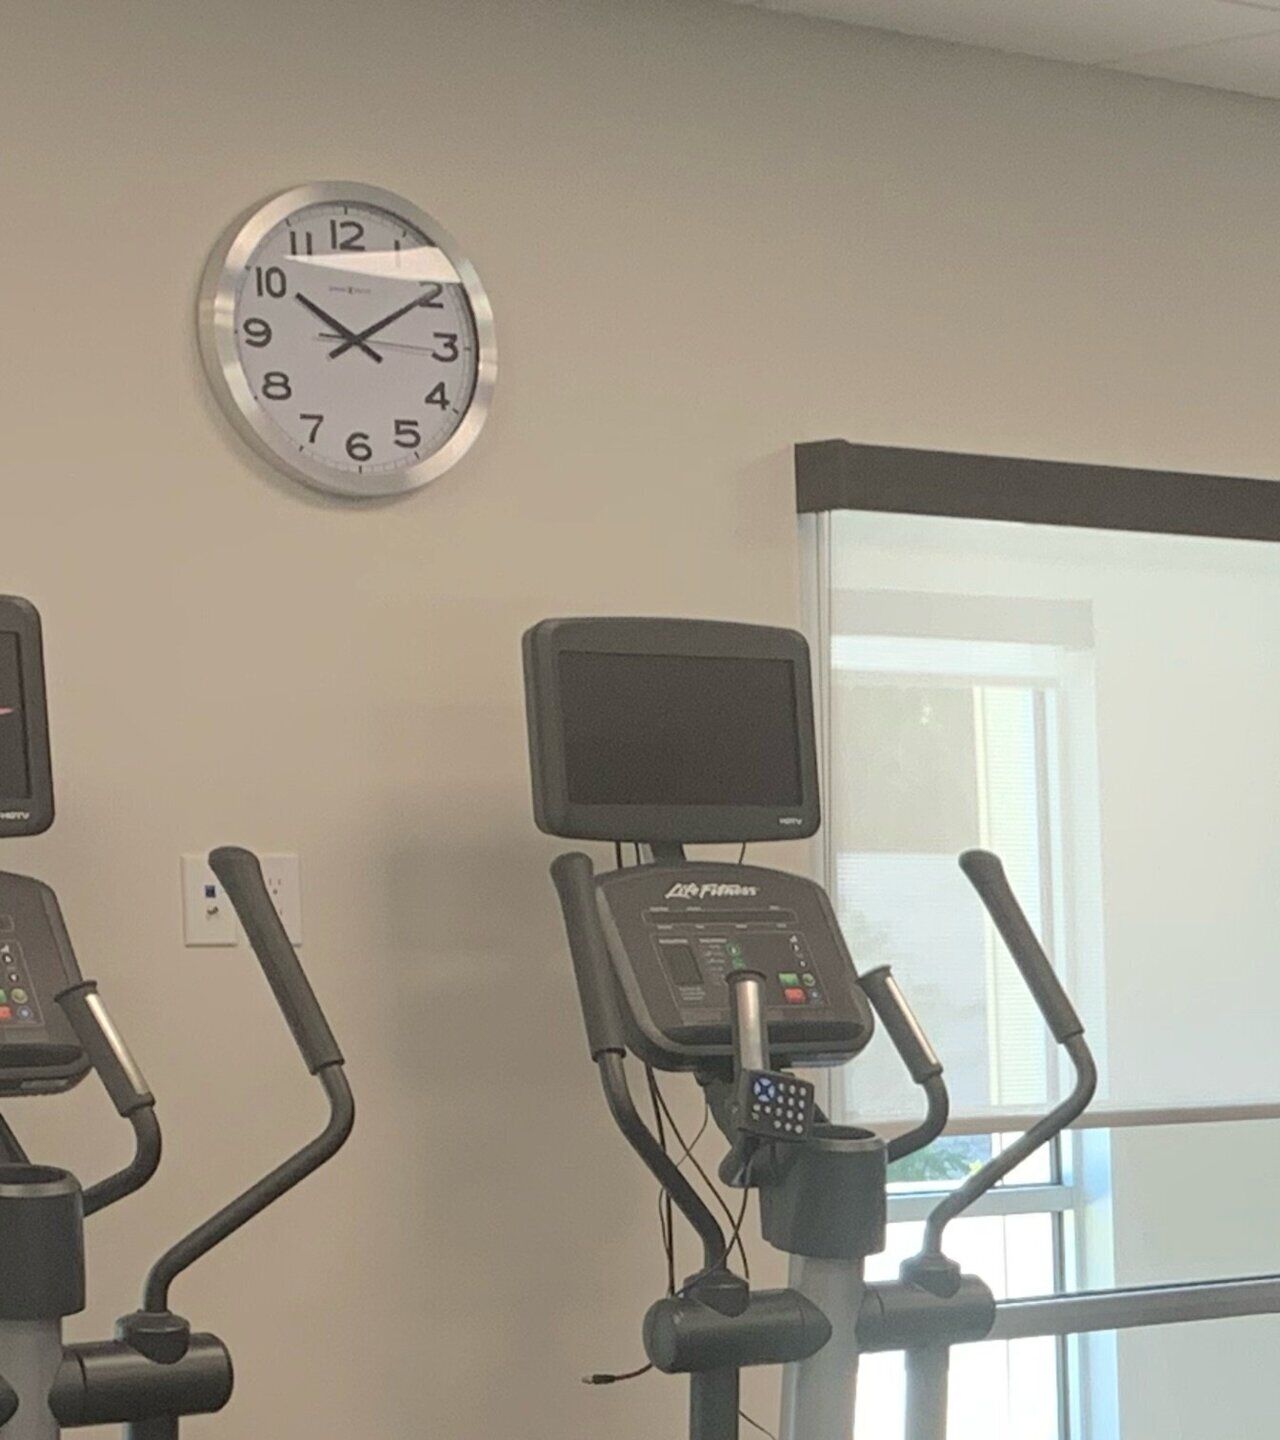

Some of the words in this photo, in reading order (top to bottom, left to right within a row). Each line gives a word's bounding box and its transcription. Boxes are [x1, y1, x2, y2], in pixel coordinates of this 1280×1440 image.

[289, 231, 313, 256] 11
[330, 219, 366, 251] 12
[255, 266, 287, 298] 10
[418, 280, 445, 309] 2
[242, 317, 273, 348] 9
[431, 332, 459, 363] 3
[261, 371, 293, 401] 8
[424, 381, 450, 411] 4
[299, 413, 324, 443] 7
[393, 419, 422, 449] 5
[345, 432, 373, 462] 6
